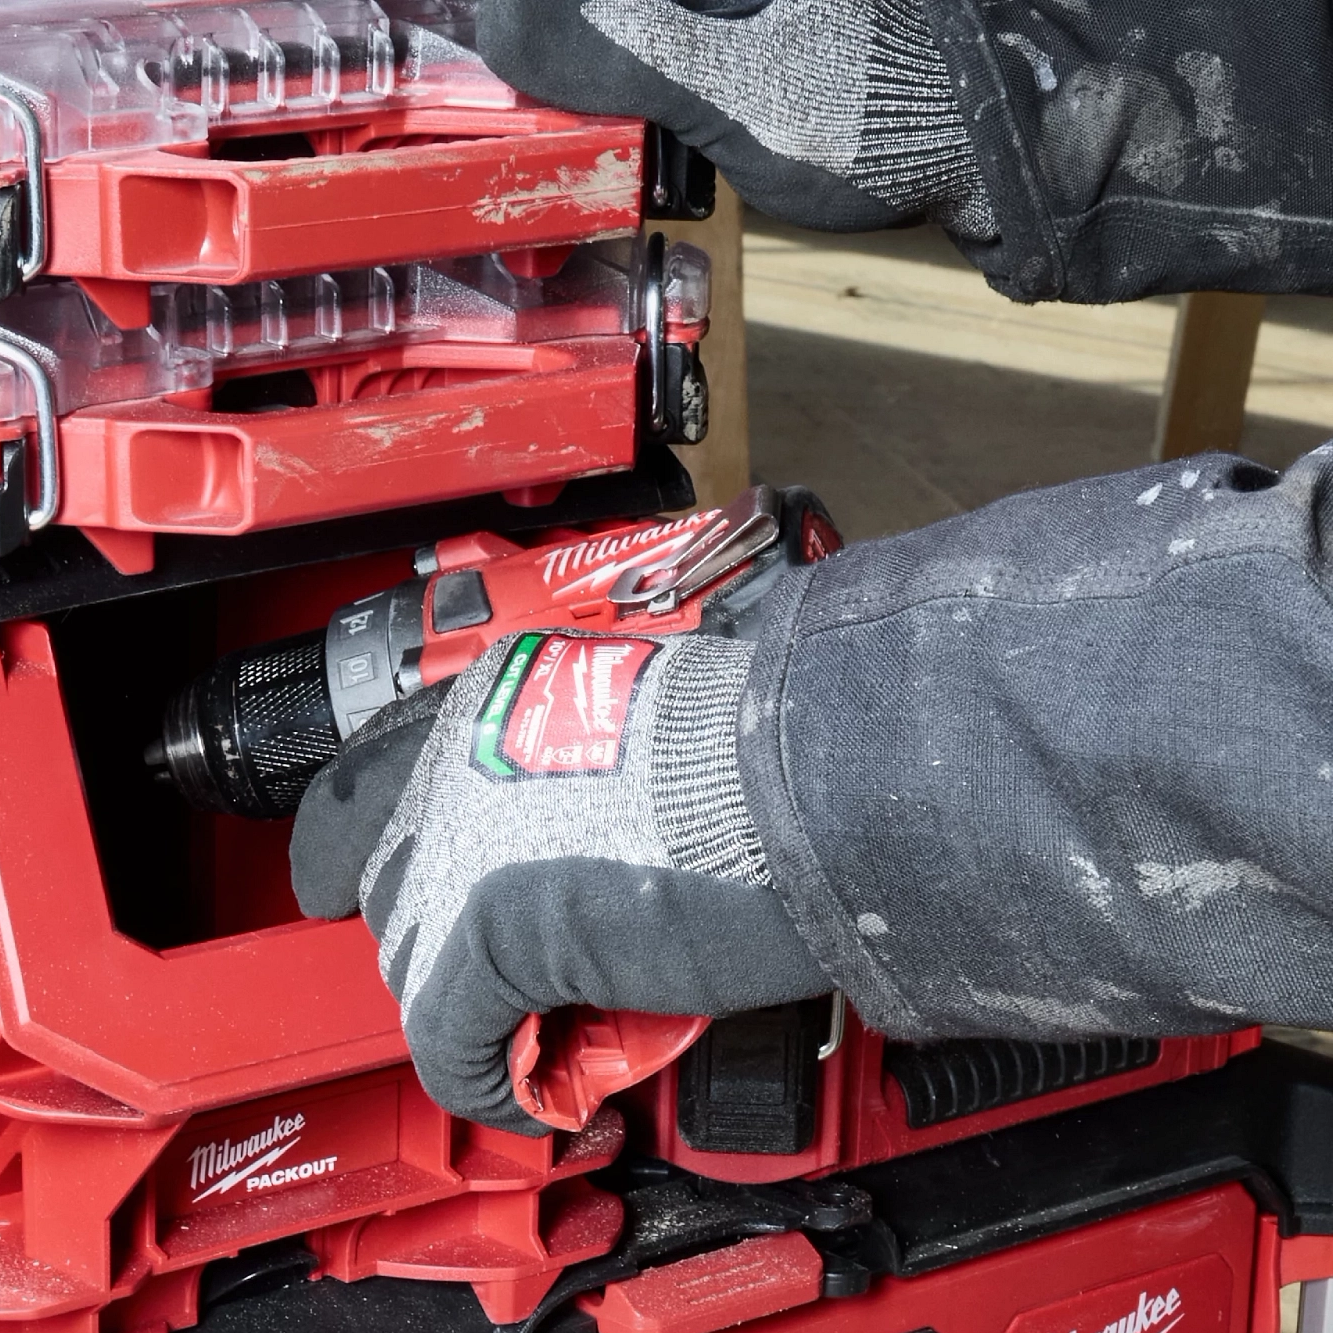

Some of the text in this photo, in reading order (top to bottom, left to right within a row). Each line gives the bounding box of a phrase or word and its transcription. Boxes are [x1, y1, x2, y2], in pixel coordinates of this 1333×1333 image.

[348, 614, 369, 636] 12
[351, 658, 369, 683] 10
[509, 653, 528, 678] CUT
[486, 680, 515, 721] LEVEL
[186, 1113, 306, 1190] Milwaukee
[246, 1156, 338, 1192] PACKOUT
